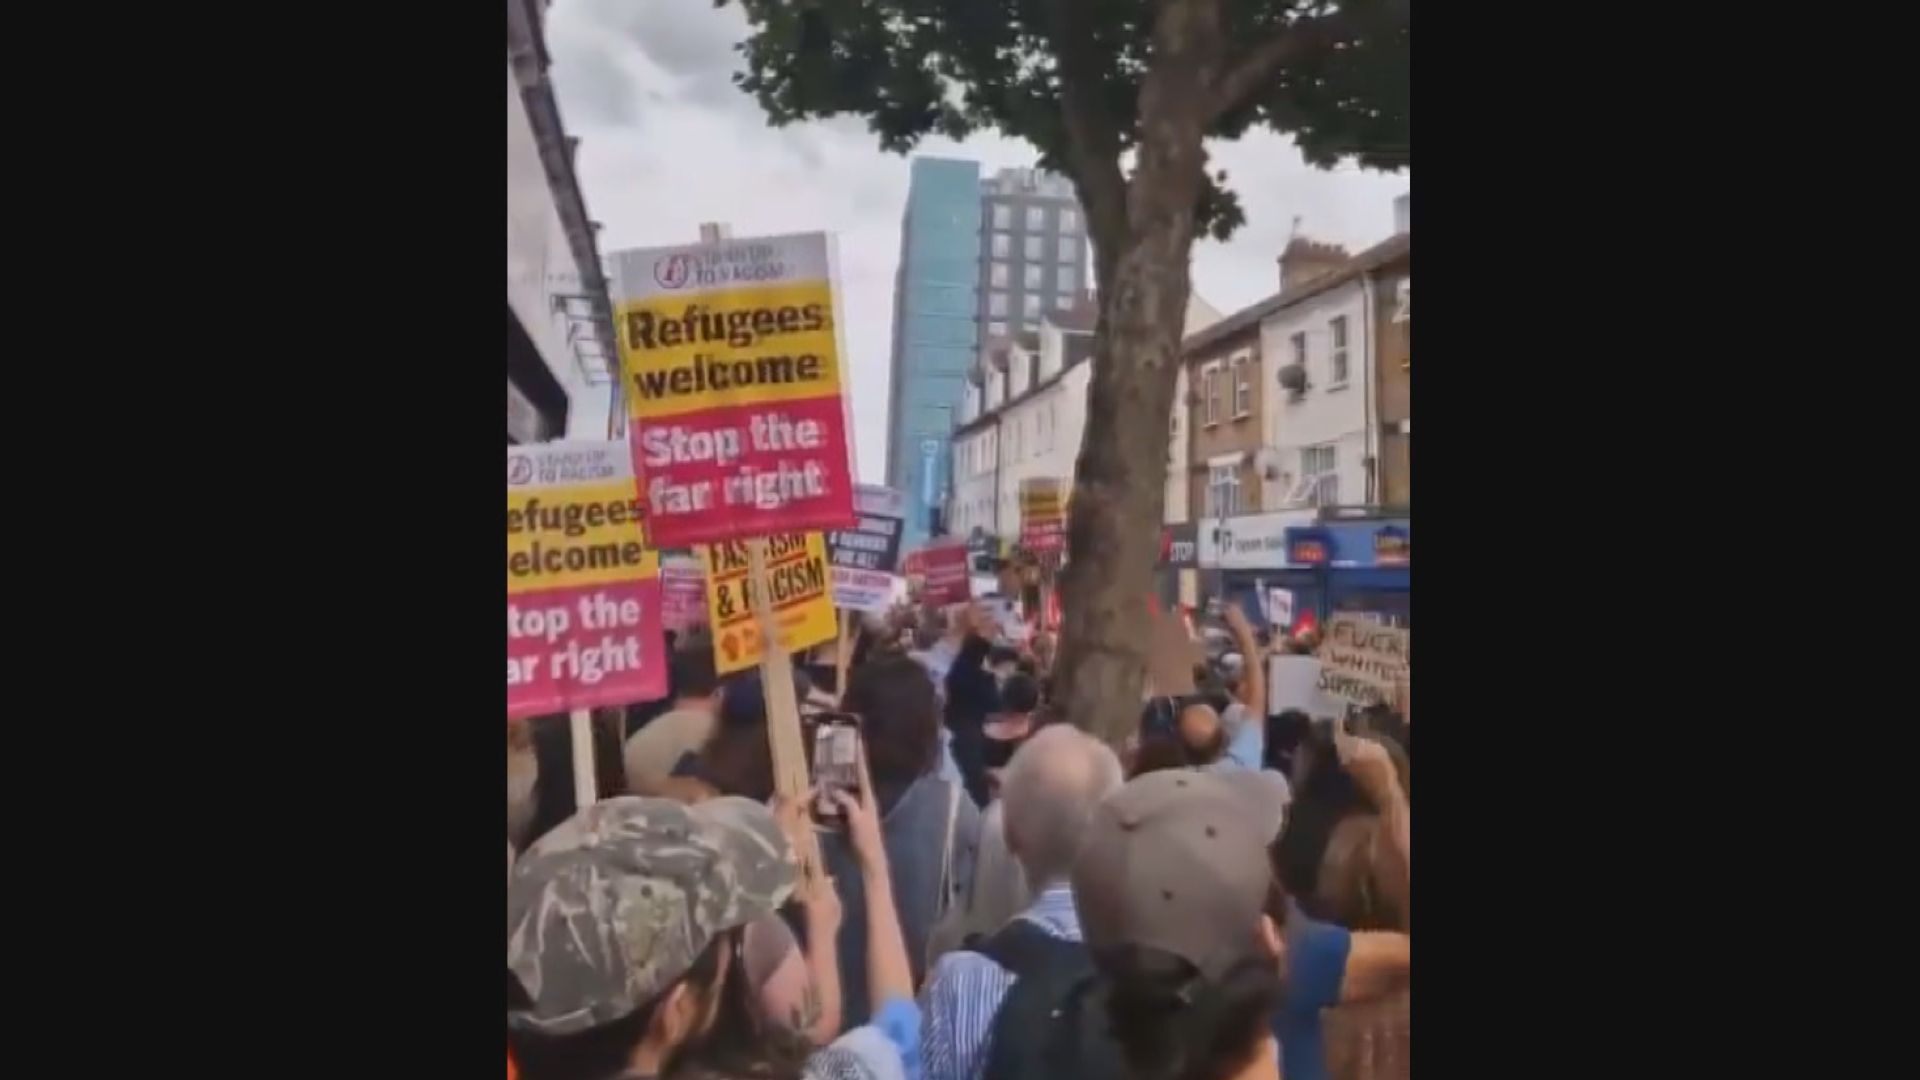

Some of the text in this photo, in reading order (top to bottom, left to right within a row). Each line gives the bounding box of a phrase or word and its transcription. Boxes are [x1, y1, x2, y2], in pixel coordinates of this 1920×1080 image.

[627, 303, 824, 350] Refugees
[634, 352, 820, 399] welcome
[644, 412, 823, 467] Stop the
[649, 475, 712, 516] far
[724, 459, 825, 509] right
[509, 540, 642, 576] elcome
[508, 604, 569, 645] top
[579, 592, 640, 630] the
[717, 583, 735, 618] &
[1335, 620, 1398, 652] FUCK
[551, 635, 641, 685] right
[1332, 650, 1395, 681] WHITE
